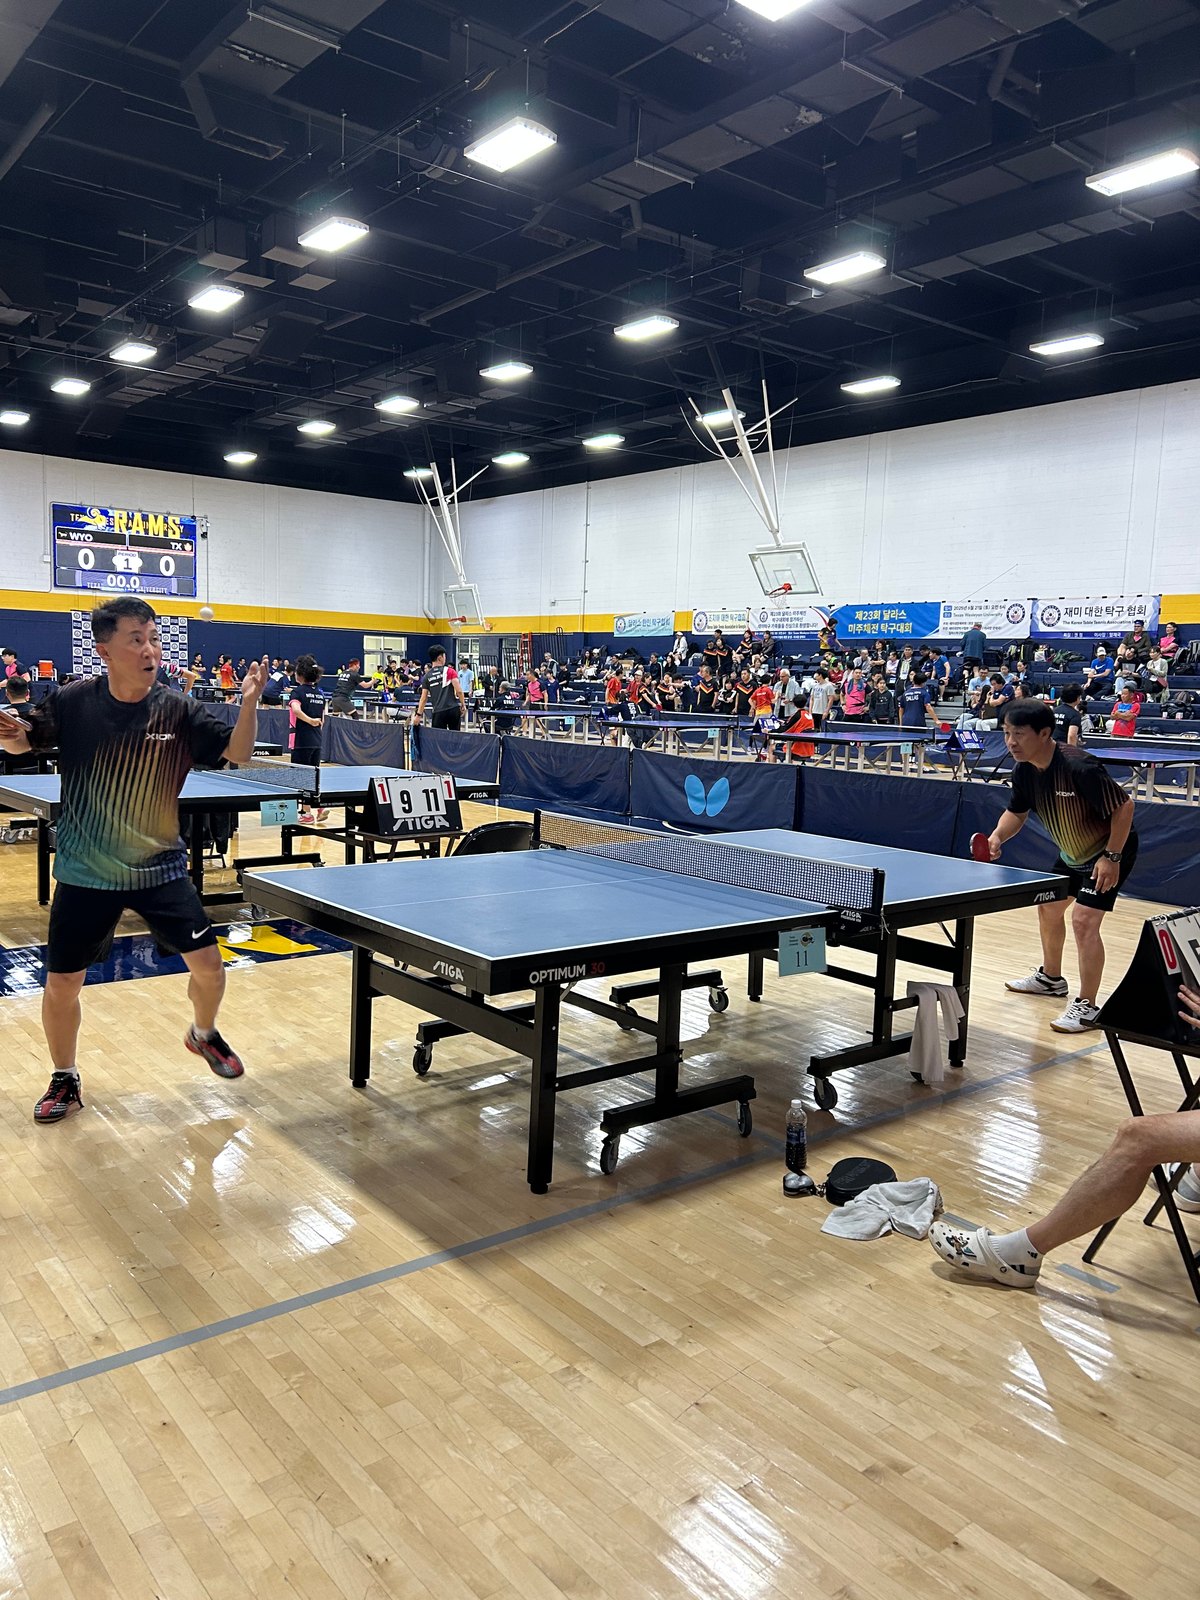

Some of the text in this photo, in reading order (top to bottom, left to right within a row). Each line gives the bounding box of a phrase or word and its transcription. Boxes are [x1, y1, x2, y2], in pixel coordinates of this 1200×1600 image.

[114, 510, 181, 538] RAMS
[68, 532, 94, 542] WYO
[170, 541, 182, 550] TX
[78, 548, 95, 570] 0
[123, 558, 132, 570] 1
[160, 555, 176, 576] 0
[106, 574, 140, 589] 00.0
[855, 609, 907, 620] 제23회 달라스
[1064, 605, 1146, 617] 재미 대한 탁구 협회
[848, 622, 912, 634] 미주체전 탁구대회
[378, 783, 387, 802] 1
[444, 780, 452, 798] 1
[400, 790, 412, 814] 9
[422, 789, 440, 812] 11
[275, 812, 285, 821] 12
[392, 816, 450, 831] STIGA
[1034, 891, 1055, 903] STIGA
[841, 910, 861, 918] STIGA
[1159, 929, 1177, 970] 0
[796, 950, 808, 967] 11
[433, 960, 464, 981] STIGA
[529, 962, 606, 984] OPTIMUM 30
